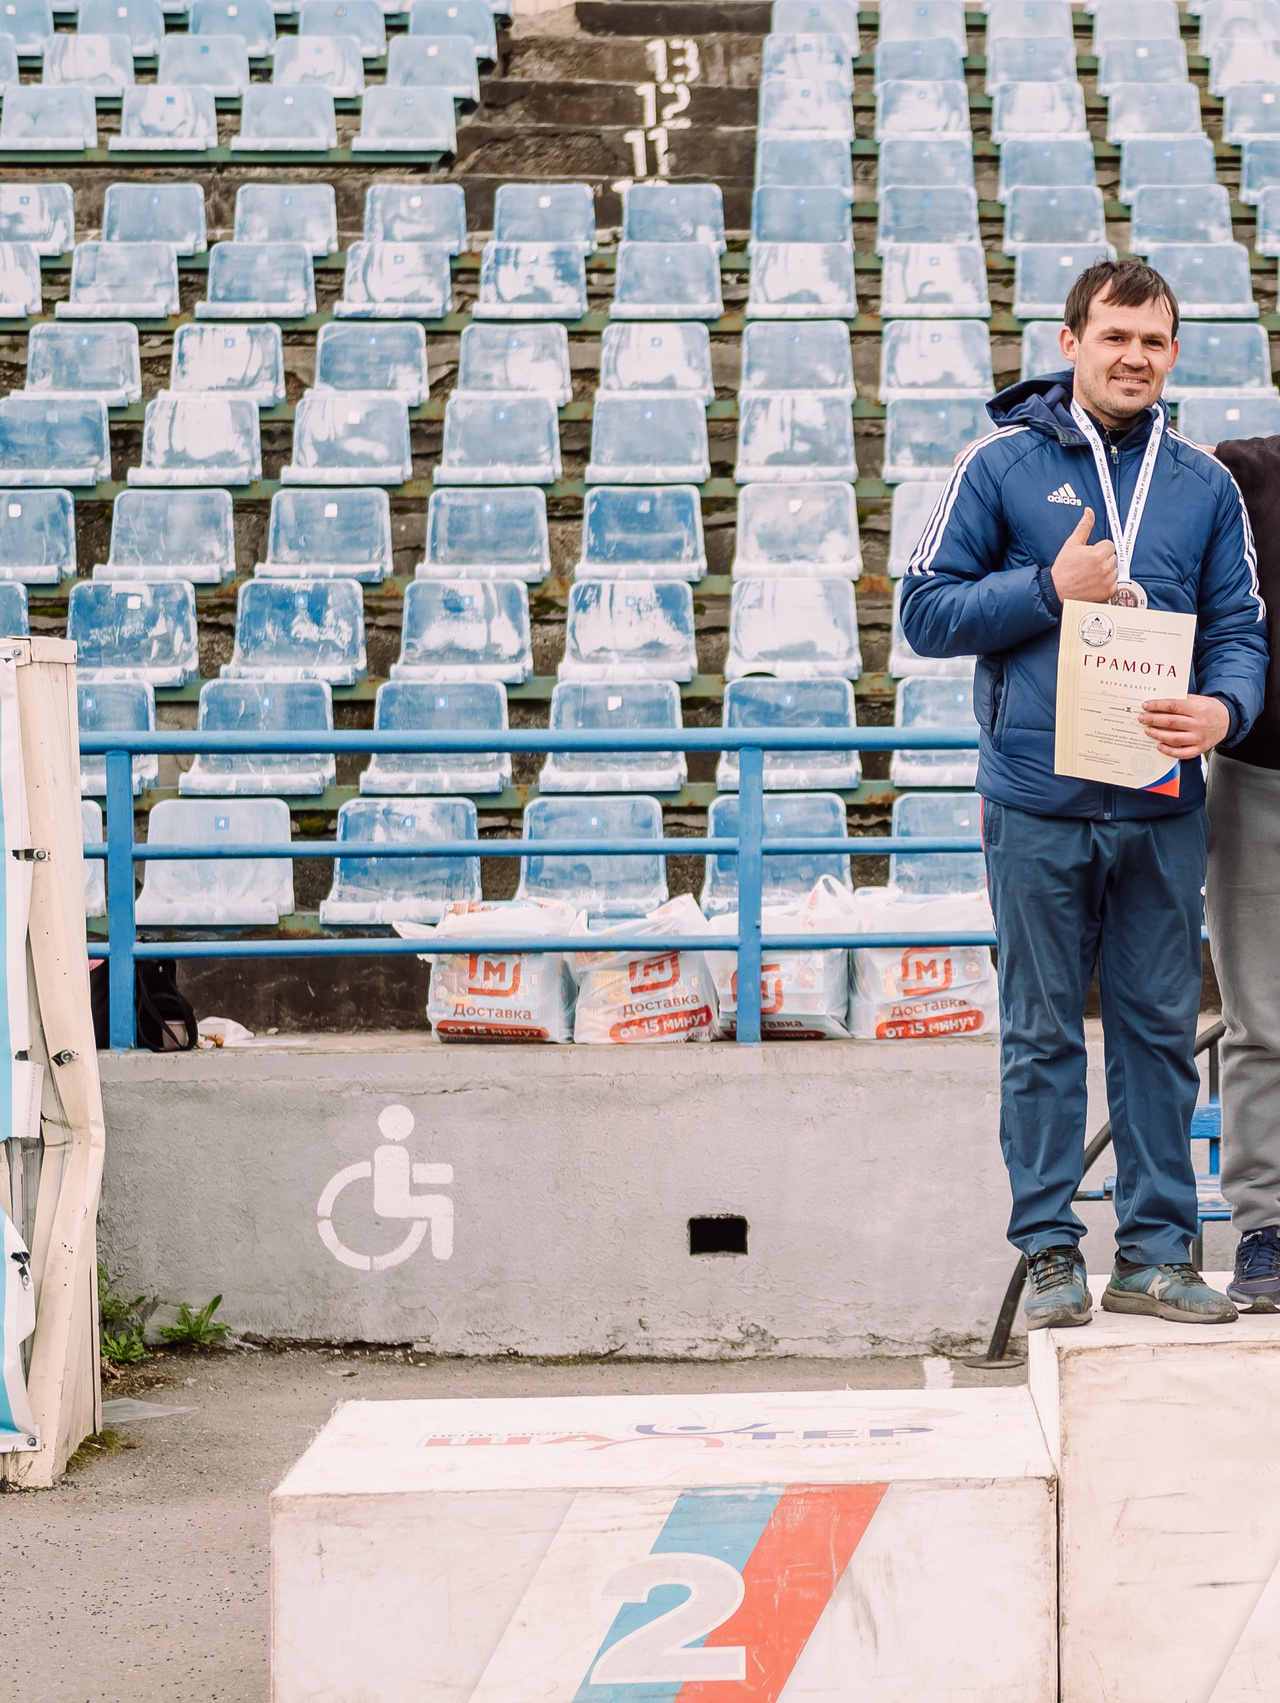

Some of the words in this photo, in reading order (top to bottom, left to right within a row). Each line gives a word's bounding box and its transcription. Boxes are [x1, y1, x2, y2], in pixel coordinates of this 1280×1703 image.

[645, 38, 700, 83] 13
[634, 82, 692, 129] 12
[623, 127, 670, 177] 11
[1047, 494, 1082, 506] adidas
[1084, 654, 1176, 677] ГРАМОТА
[1100, 680, 1156, 691] НАГРАЖДАЕТСЯ
[453, 1003, 532, 1020] Доставка
[623, 994, 700, 1017] Доставка
[891, 999, 968, 1018] Доставка
[469, 1025, 487, 1034] 15
[491, 1028, 540, 1037] минут
[620, 1022, 638, 1039] от
[641, 1017, 660, 1035] 15
[662, 1012, 707, 1031] минут
[886, 1024, 903, 1039] от
[907, 1020, 925, 1035] 15
[928, 1014, 977, 1033] минут
[424, 1422, 934, 1451] ШАХТЕР
[736, 1440, 902, 1450] СТАДИОН
[589, 1551, 747, 1685] 2
